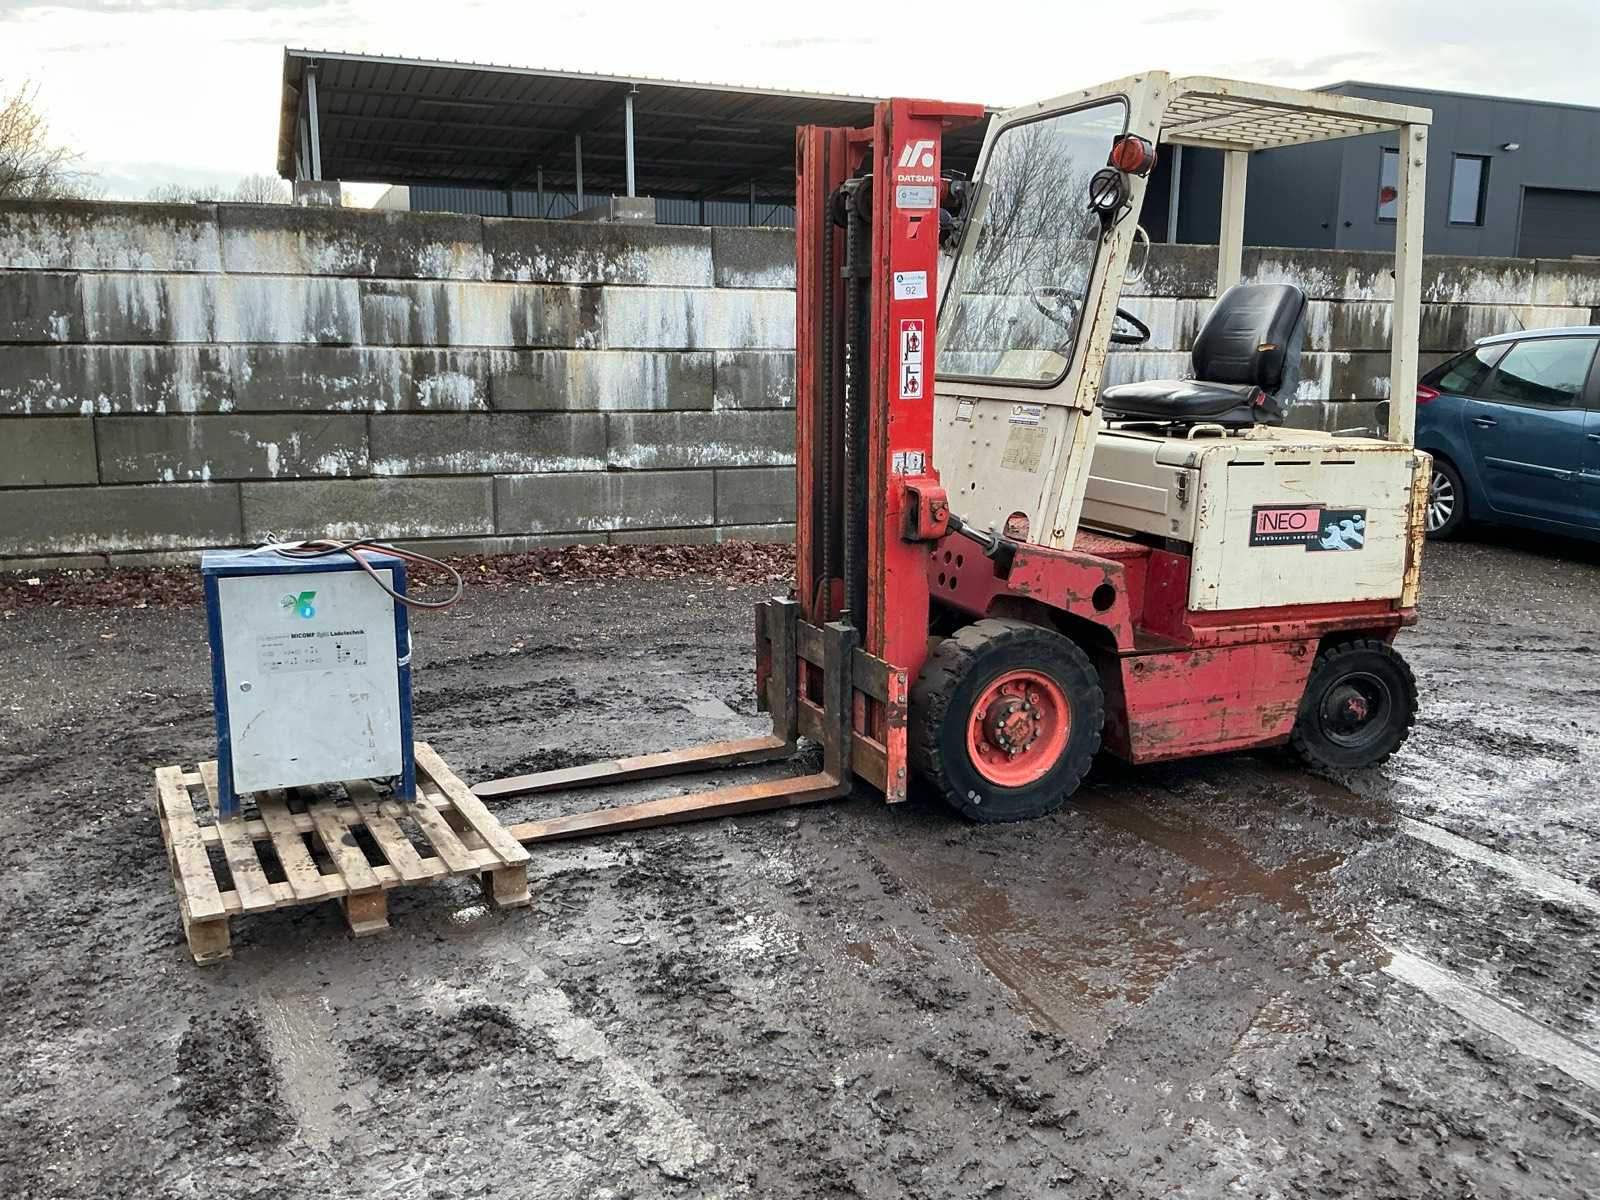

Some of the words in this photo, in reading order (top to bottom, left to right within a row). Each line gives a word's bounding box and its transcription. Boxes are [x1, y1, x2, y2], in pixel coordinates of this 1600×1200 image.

[897, 174, 934, 182] DATSUN
[905, 286, 917, 295] 92
[1263, 512, 1307, 530] NEO
